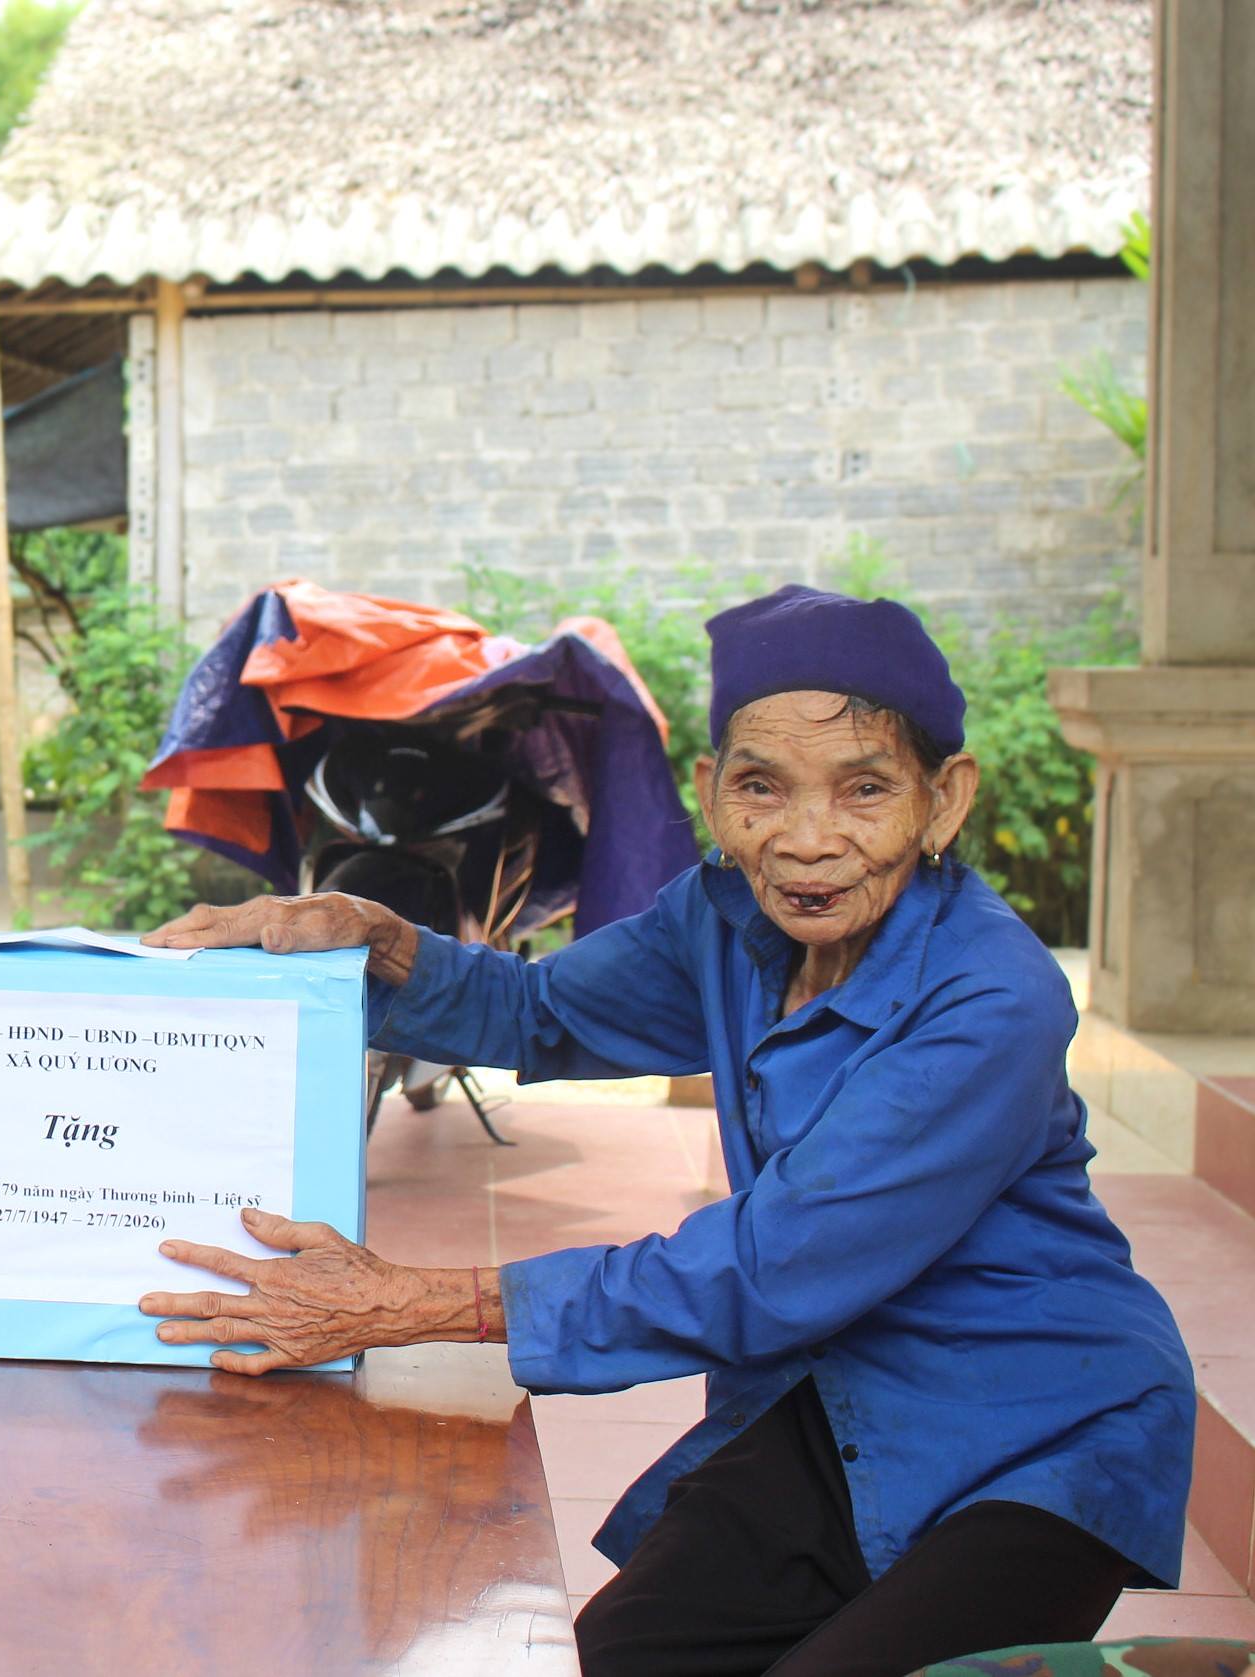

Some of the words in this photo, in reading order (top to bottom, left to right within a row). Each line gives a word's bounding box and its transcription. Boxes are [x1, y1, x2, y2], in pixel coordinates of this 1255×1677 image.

[8, 1026, 64, 1041] HĐND
[84, 1028, 137, 1045] UBND
[6, 1050, 32, 1068] XÃ
[38, 1052, 80, 1071] QUÝ
[86, 1056, 157, 1073] LƯƠNG
[43, 1114, 119, 1150] Tặng
[2, 1183, 18, 1196] 79
[23, 1185, 54, 1198] năm
[60, 1187, 94, 1203] ngày
[99, 1187, 157, 1205] Thương
[214, 1192, 241, 1208] Liệt
[247, 1195, 262, 1209] sỹ
[87, 1213, 166, 1231] 27/7/2026)
